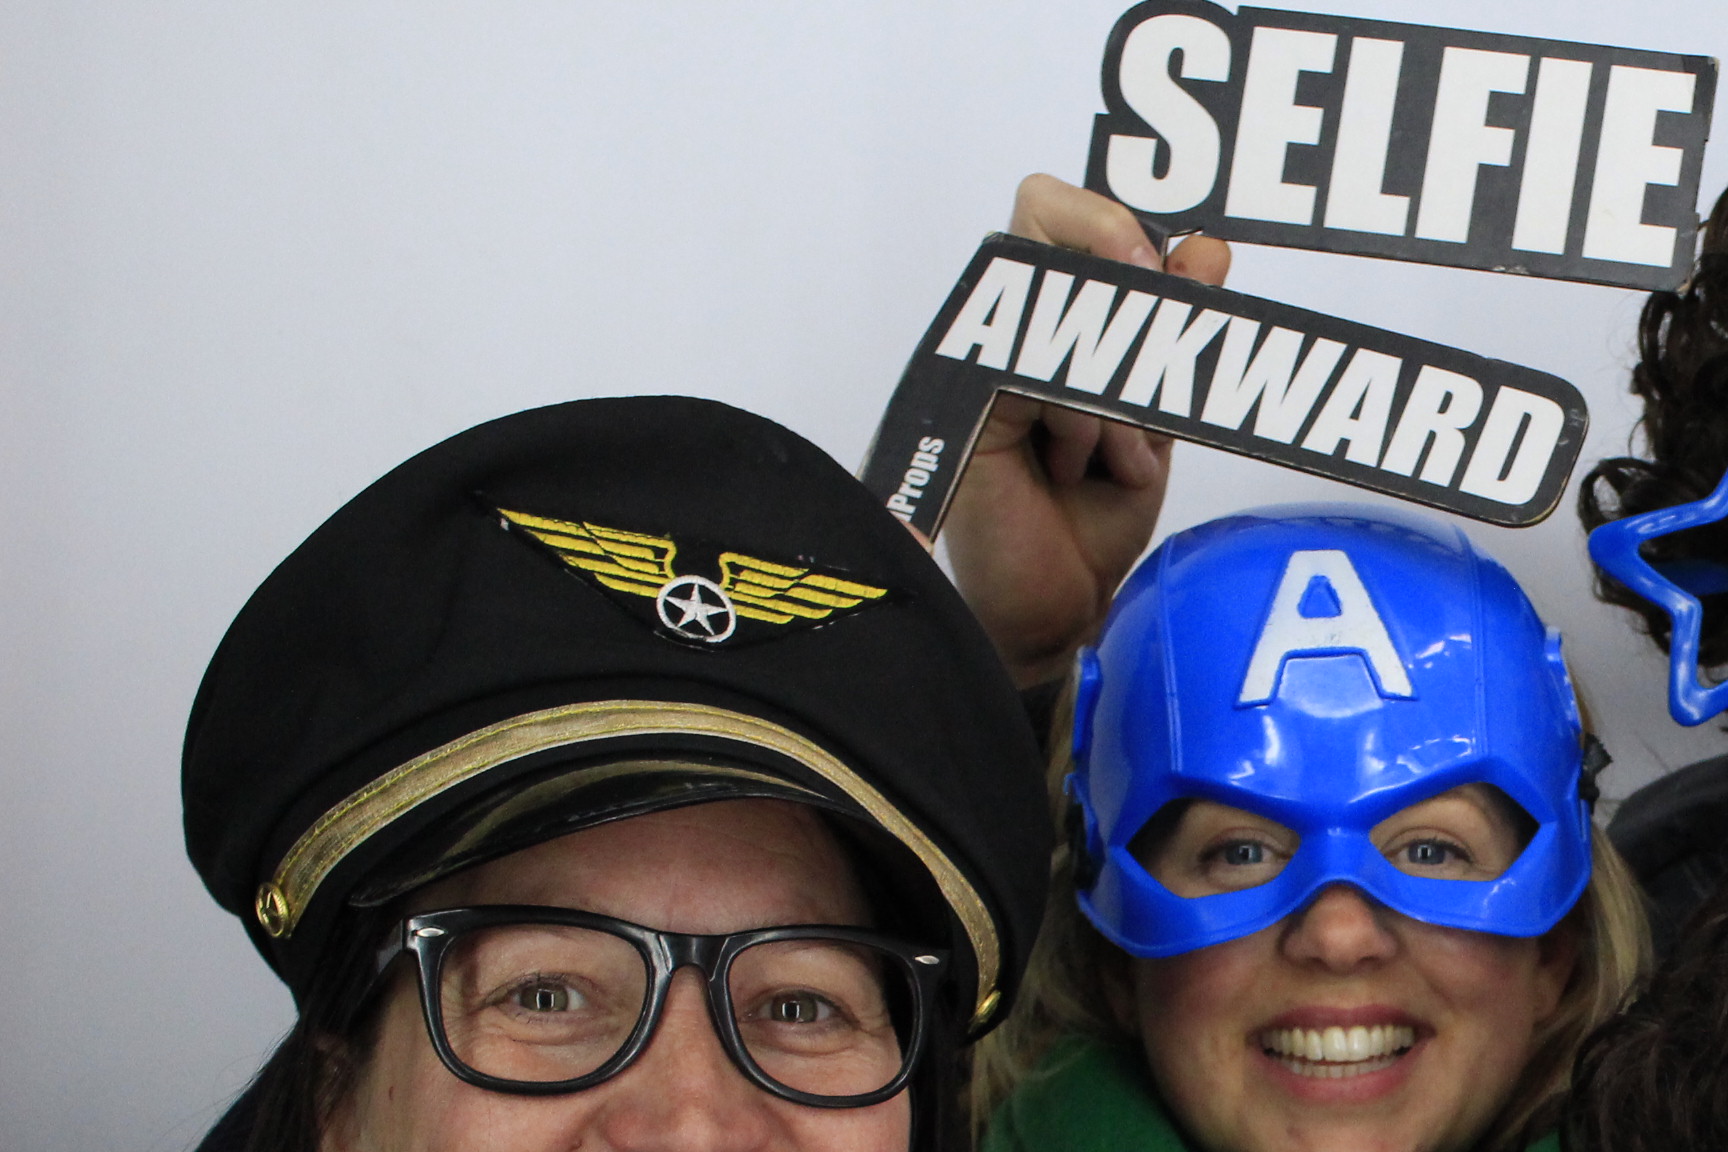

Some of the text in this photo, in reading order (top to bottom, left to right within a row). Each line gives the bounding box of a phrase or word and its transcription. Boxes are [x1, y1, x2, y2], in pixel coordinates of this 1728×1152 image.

[1106, 13, 1697, 268] SELFIE
[935, 256, 1567, 506] AWKWARD
[1237, 550, 1417, 708] A
